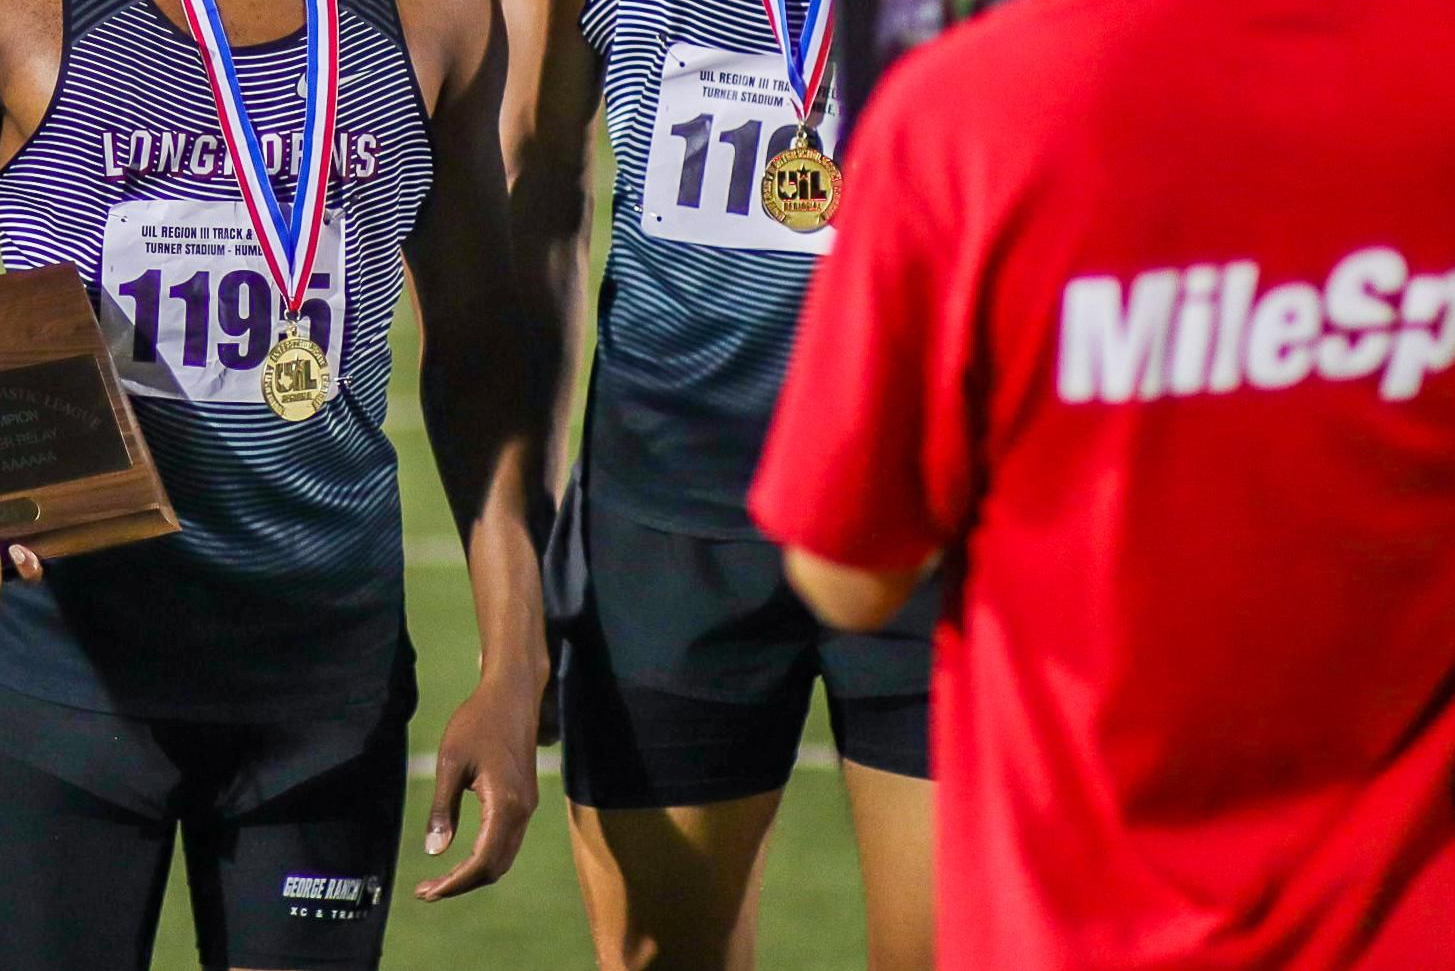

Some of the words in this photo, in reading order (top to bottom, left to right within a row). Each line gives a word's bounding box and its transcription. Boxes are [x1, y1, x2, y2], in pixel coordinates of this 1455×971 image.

[699, 70, 715, 82] UIL
[719, 71, 755, 87] REGION
[758, 78, 769, 89] III
[702, 86, 738, 101] TURNER
[740, 92, 784, 107] STADIUM
[141, 225, 157, 237] UIL
[161, 226, 197, 239] REGION
[200, 227, 210, 239] III
[213, 227, 243, 240] TRACK
[246, 229, 253, 240] &
[145, 242, 182, 255] TURNER
[185, 243, 225, 255] STADIUM
[16, 427, 57, 446] RELAY
[283, 877, 327, 899] GEORGE
[290, 906, 308, 917] XC
[315, 909, 323, 918] &
